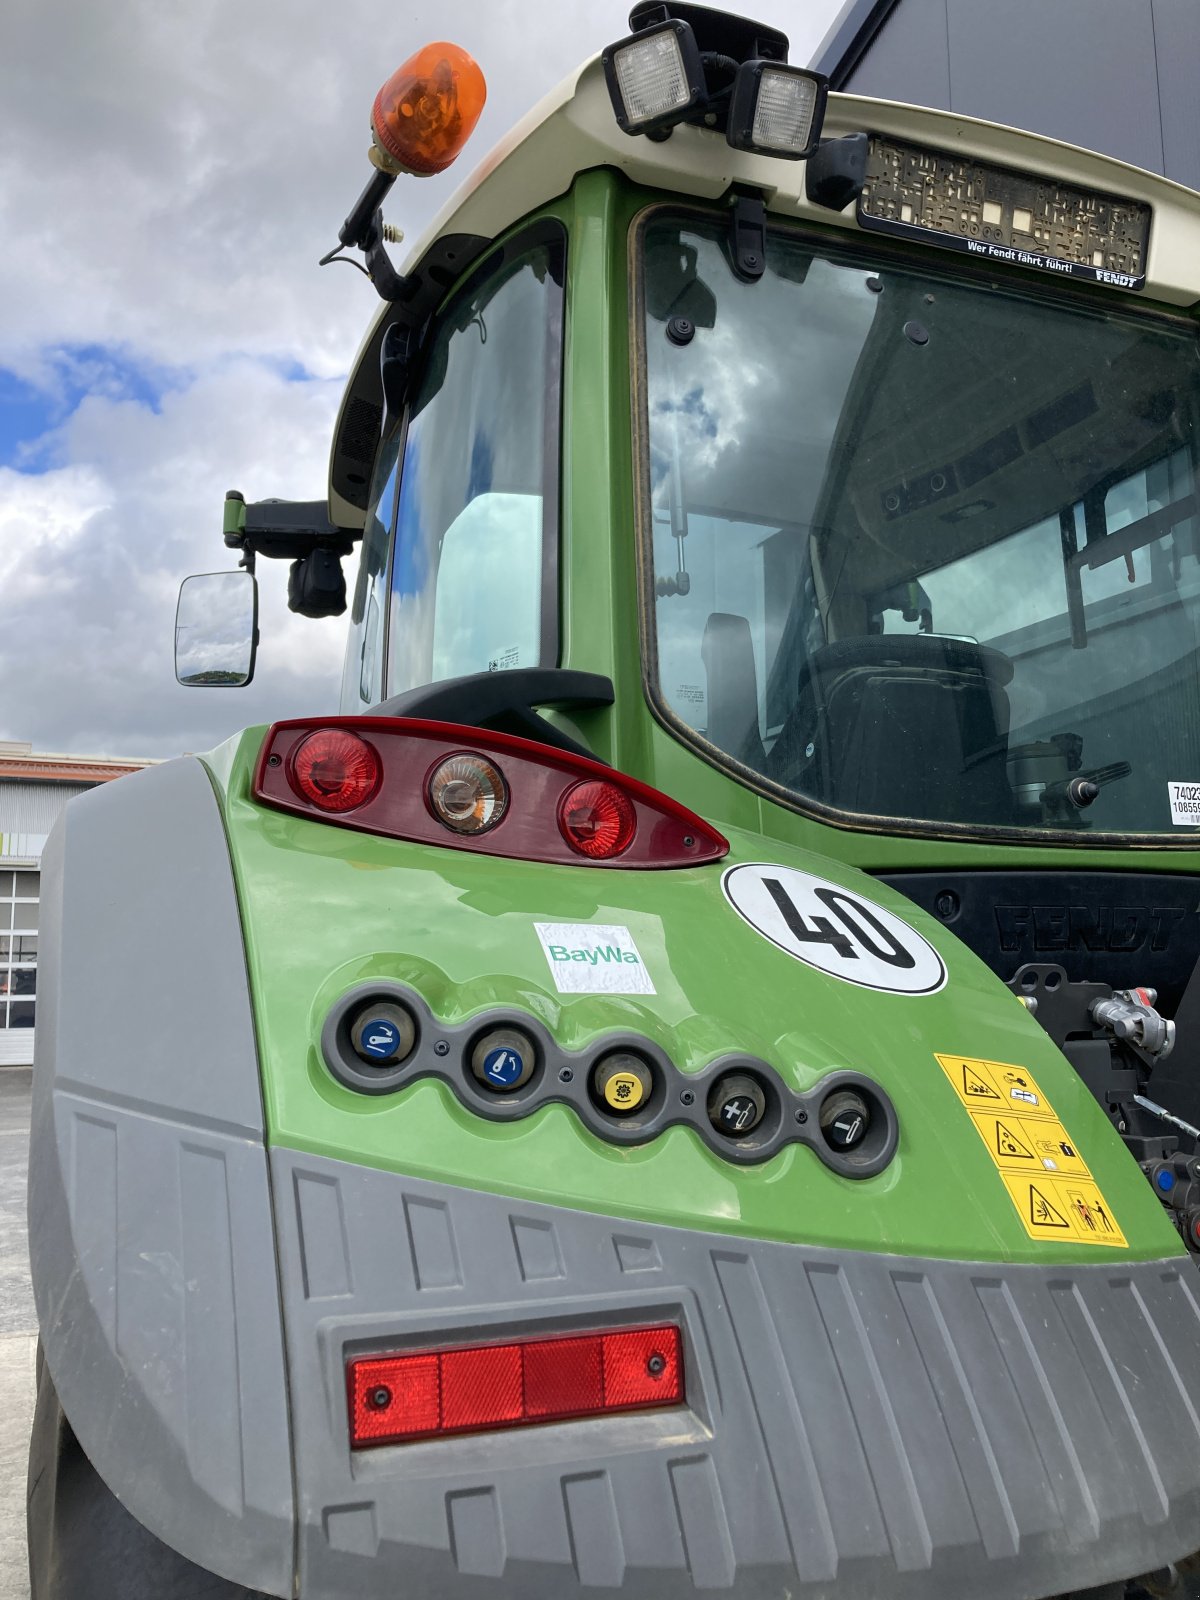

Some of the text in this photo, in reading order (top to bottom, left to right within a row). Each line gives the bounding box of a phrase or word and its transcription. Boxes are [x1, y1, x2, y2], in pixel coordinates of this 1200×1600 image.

[967, 241, 1073, 273] Wer Fendt fährt, führt!
[1095, 270, 1137, 288] FENDT
[760, 877, 916, 969] 40
[994, 905, 1186, 951] FENDT
[547, 944, 640, 966] BayWa
